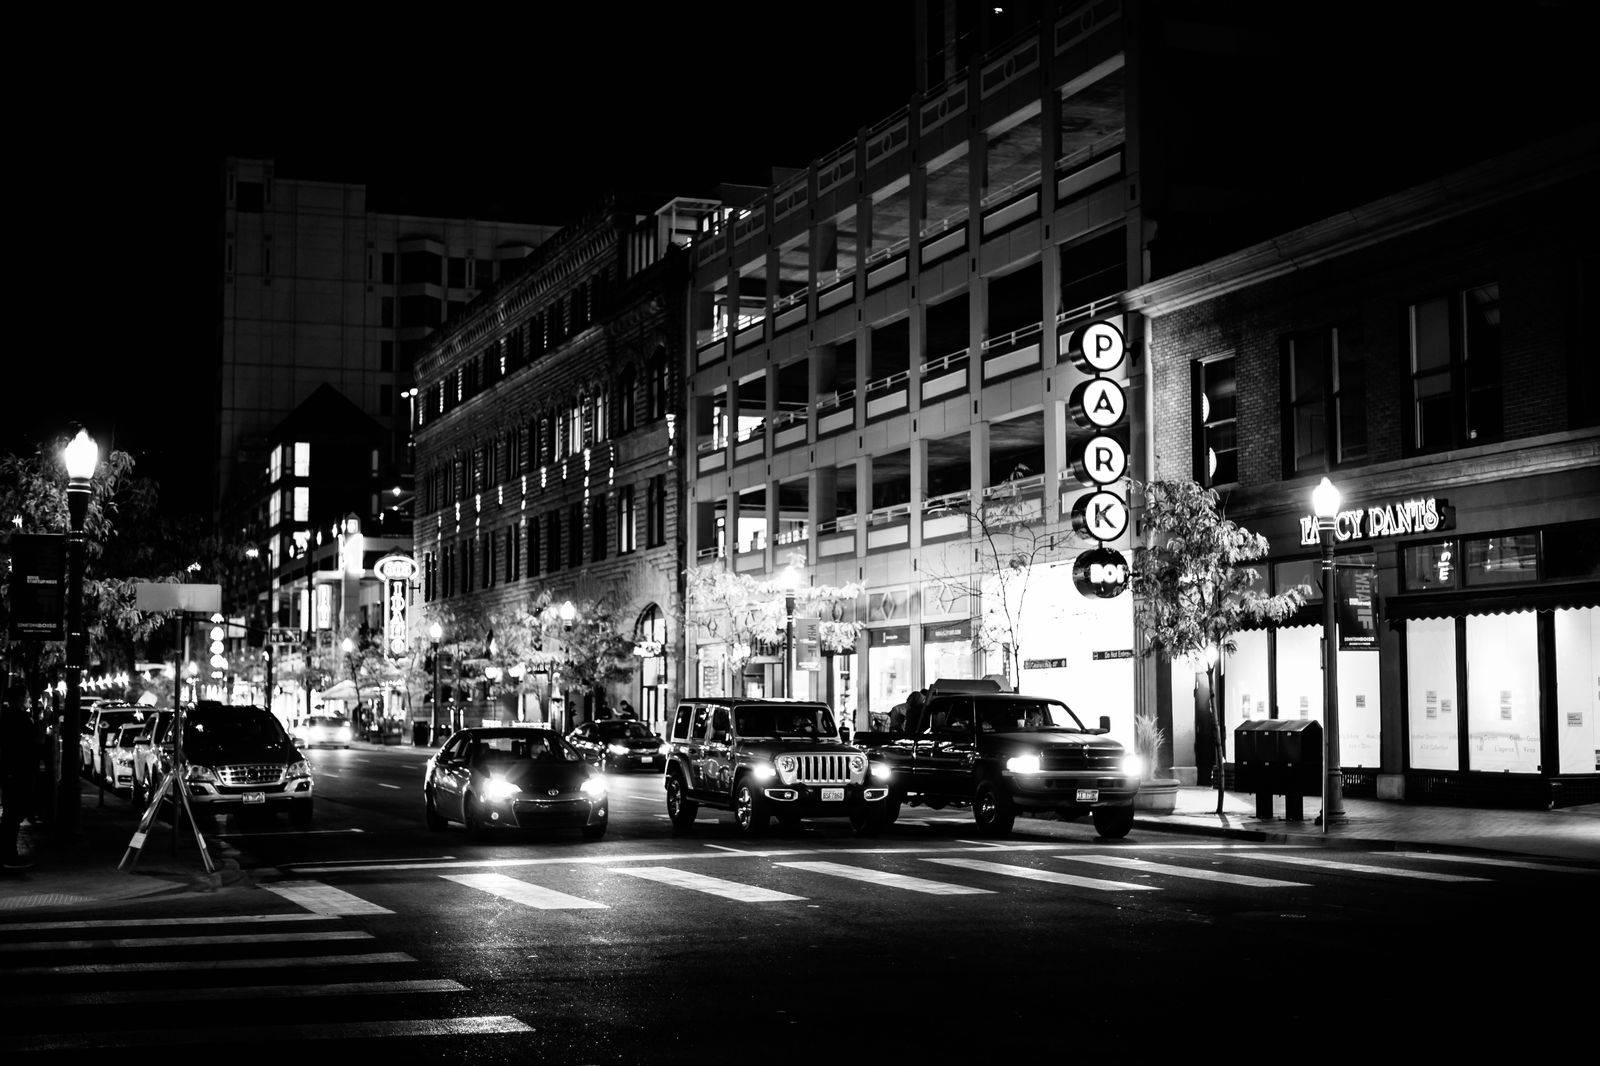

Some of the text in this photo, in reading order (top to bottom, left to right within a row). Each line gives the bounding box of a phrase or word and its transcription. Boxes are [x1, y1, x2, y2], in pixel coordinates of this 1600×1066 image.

[1093, 333, 1117, 529] PARK
[1300, 498, 1439, 546] FACY PANTS
